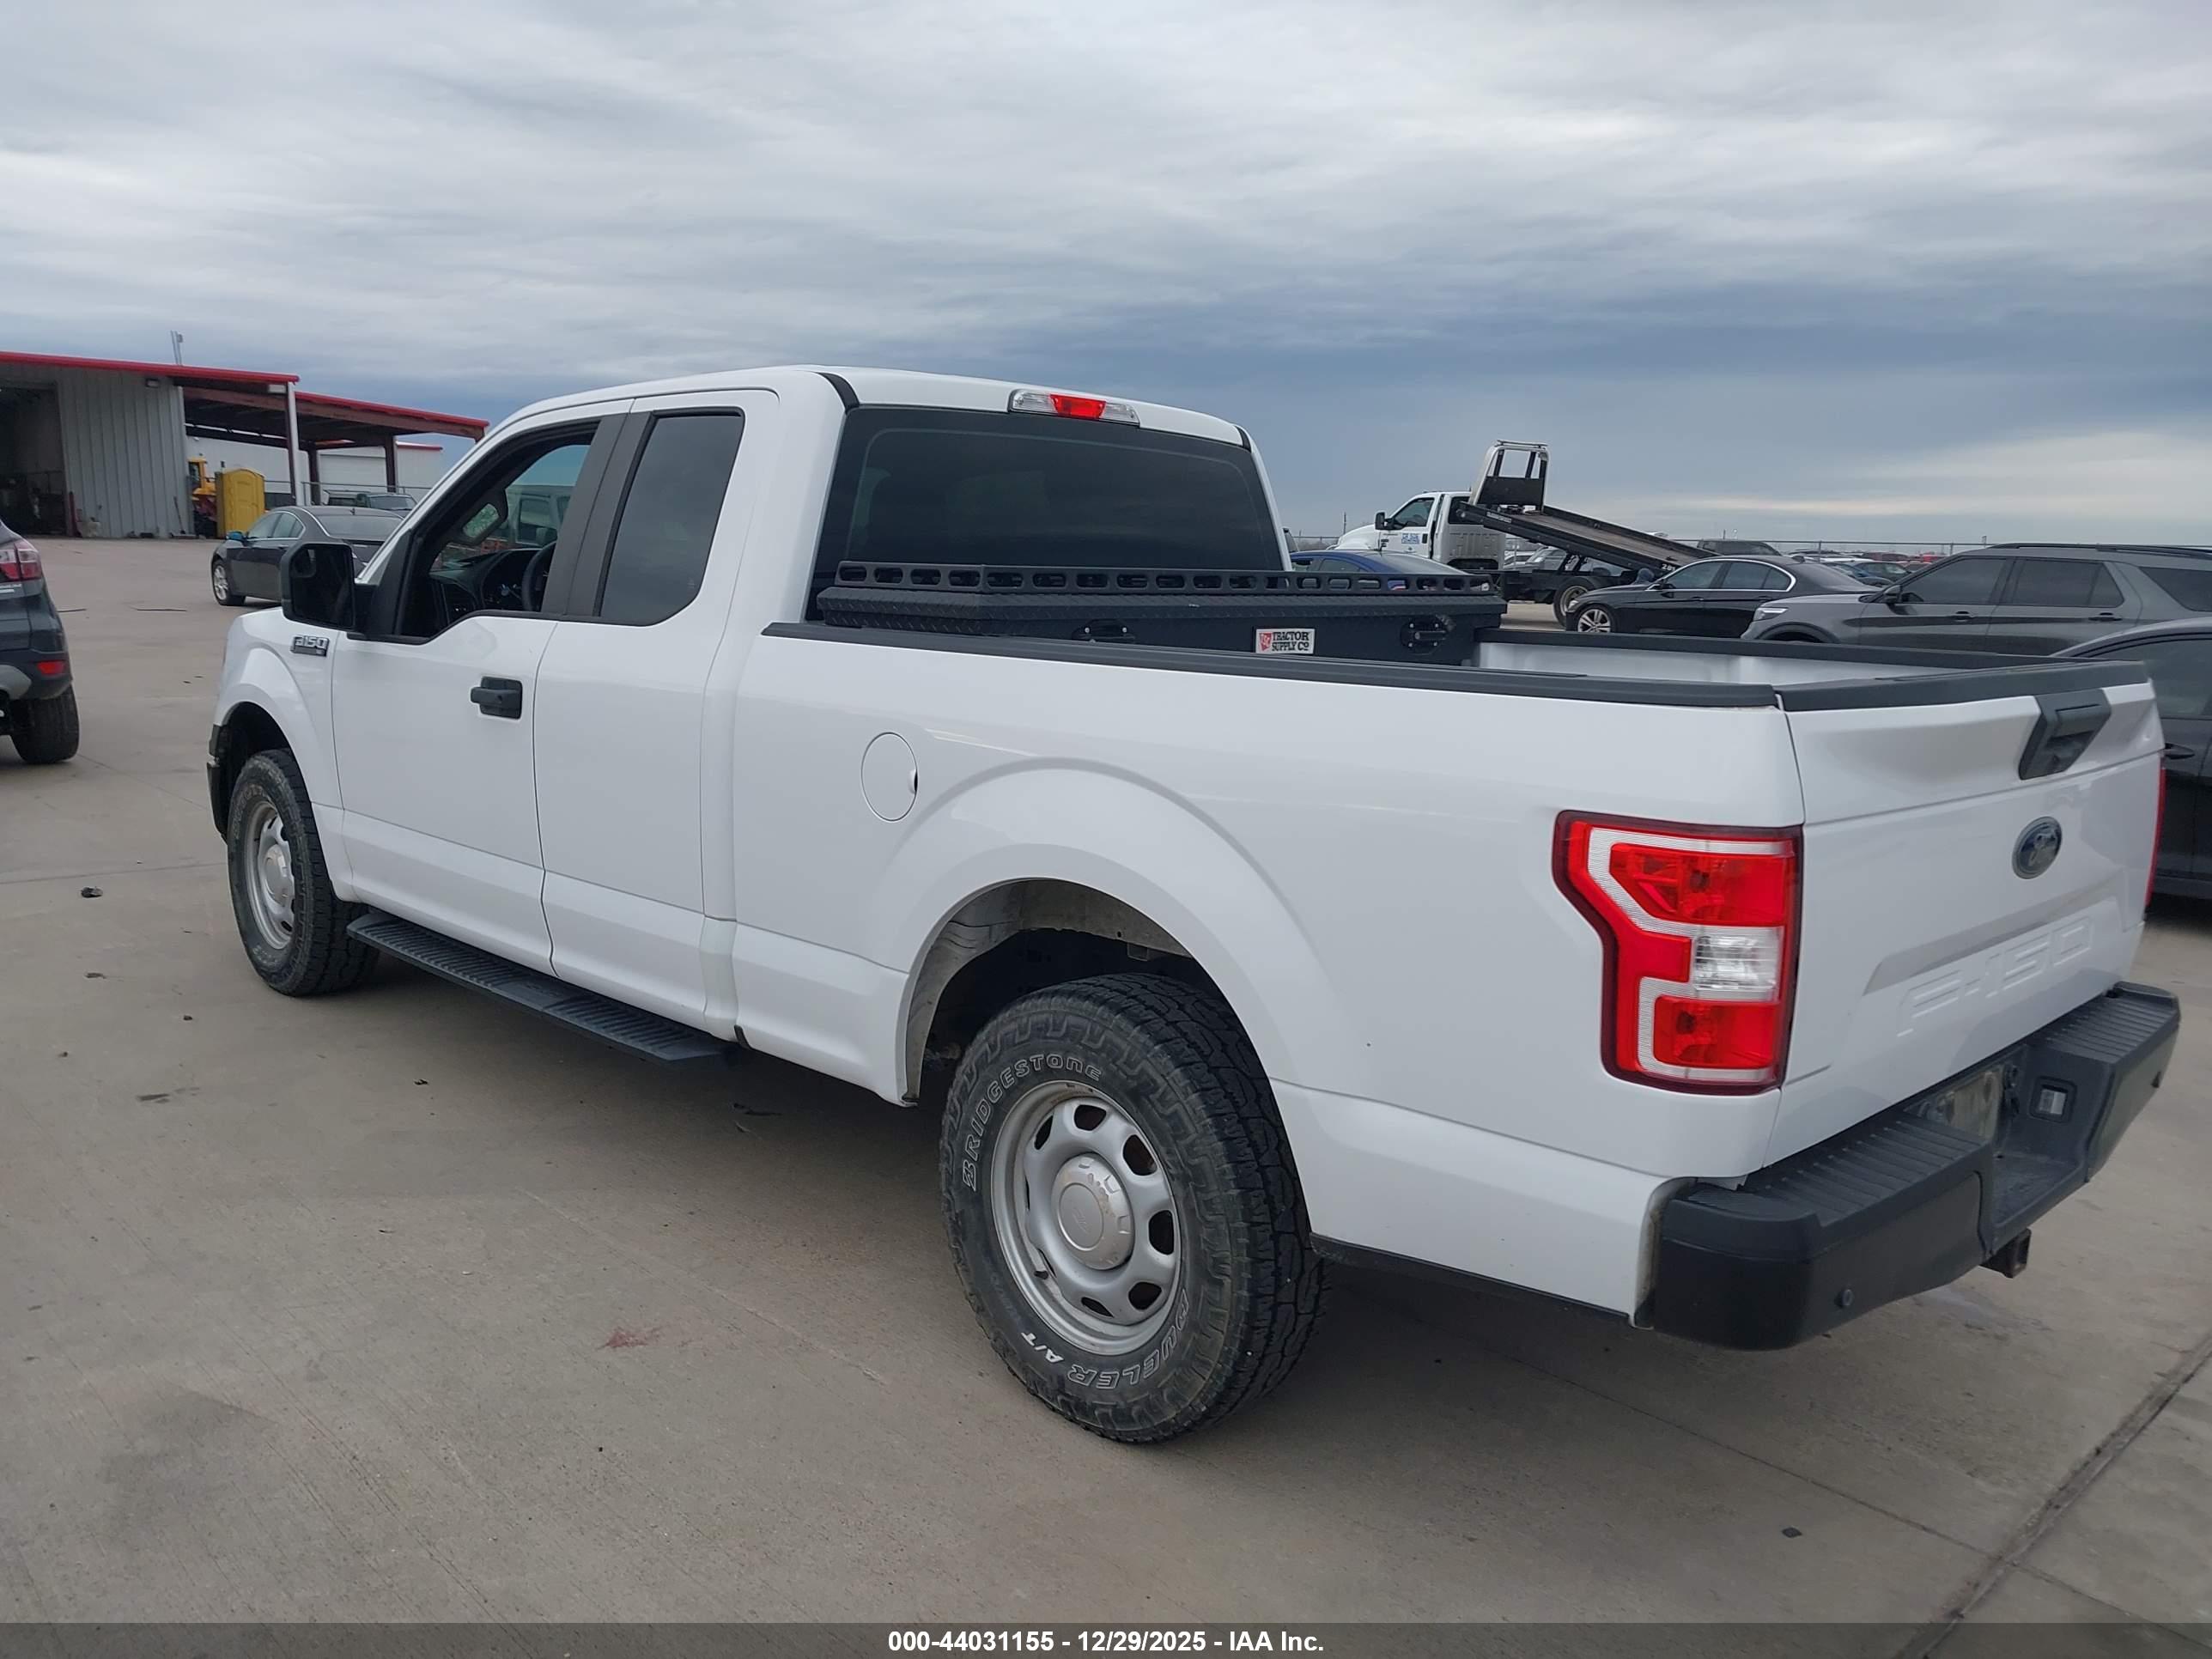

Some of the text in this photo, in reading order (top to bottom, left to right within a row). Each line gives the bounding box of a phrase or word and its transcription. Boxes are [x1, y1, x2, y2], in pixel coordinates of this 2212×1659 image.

[1272, 631, 1310, 641] TRACTOR
[1272, 641, 1297, 652] SUPPLY
[962, 1053, 1103, 1192] BRIDGESTONE
[1020, 1330, 1065, 1364] A/T
